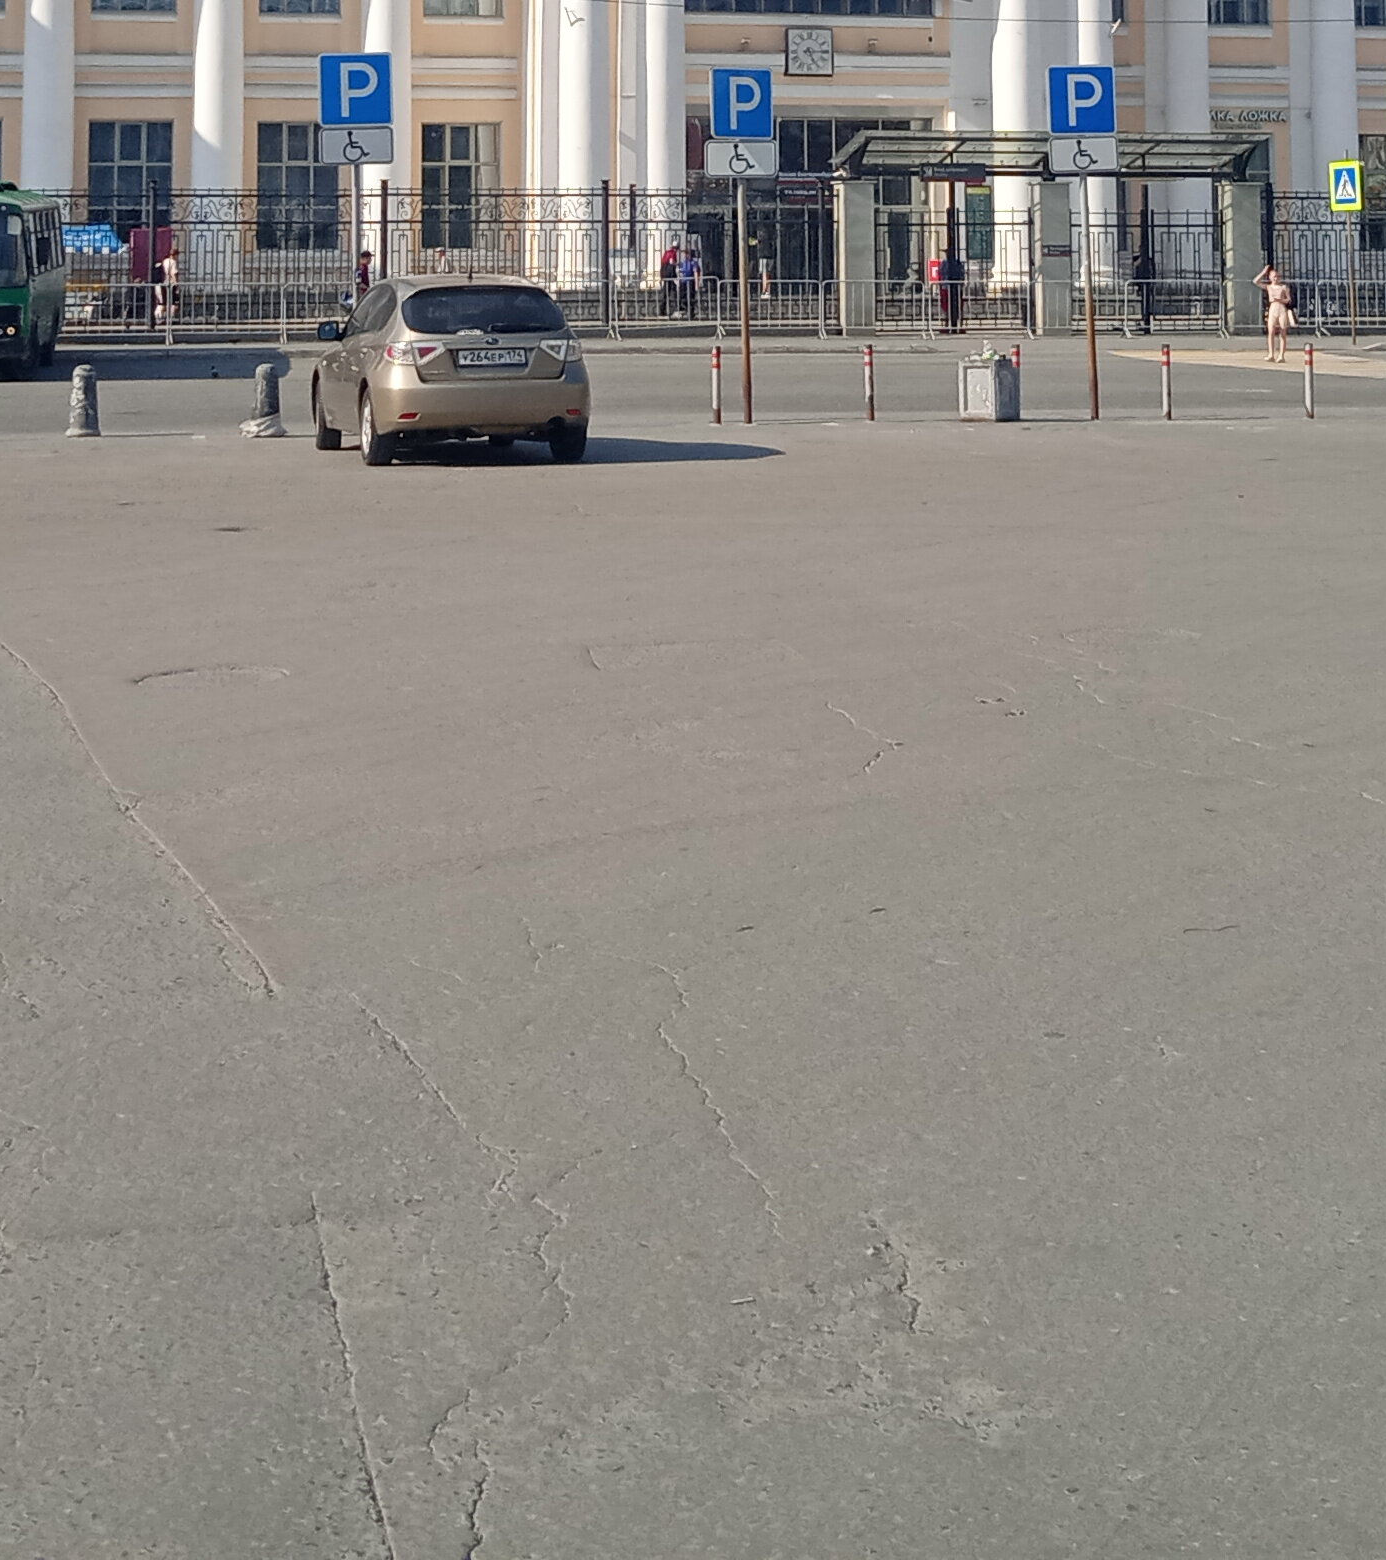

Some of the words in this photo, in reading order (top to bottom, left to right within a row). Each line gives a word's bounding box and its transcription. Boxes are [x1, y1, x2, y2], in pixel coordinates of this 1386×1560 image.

[340, 62, 378, 117] P
[729, 76, 761, 130] P
[1067, 73, 1102, 127] P
[1239, 110, 1287, 122] ЛОЖКА
